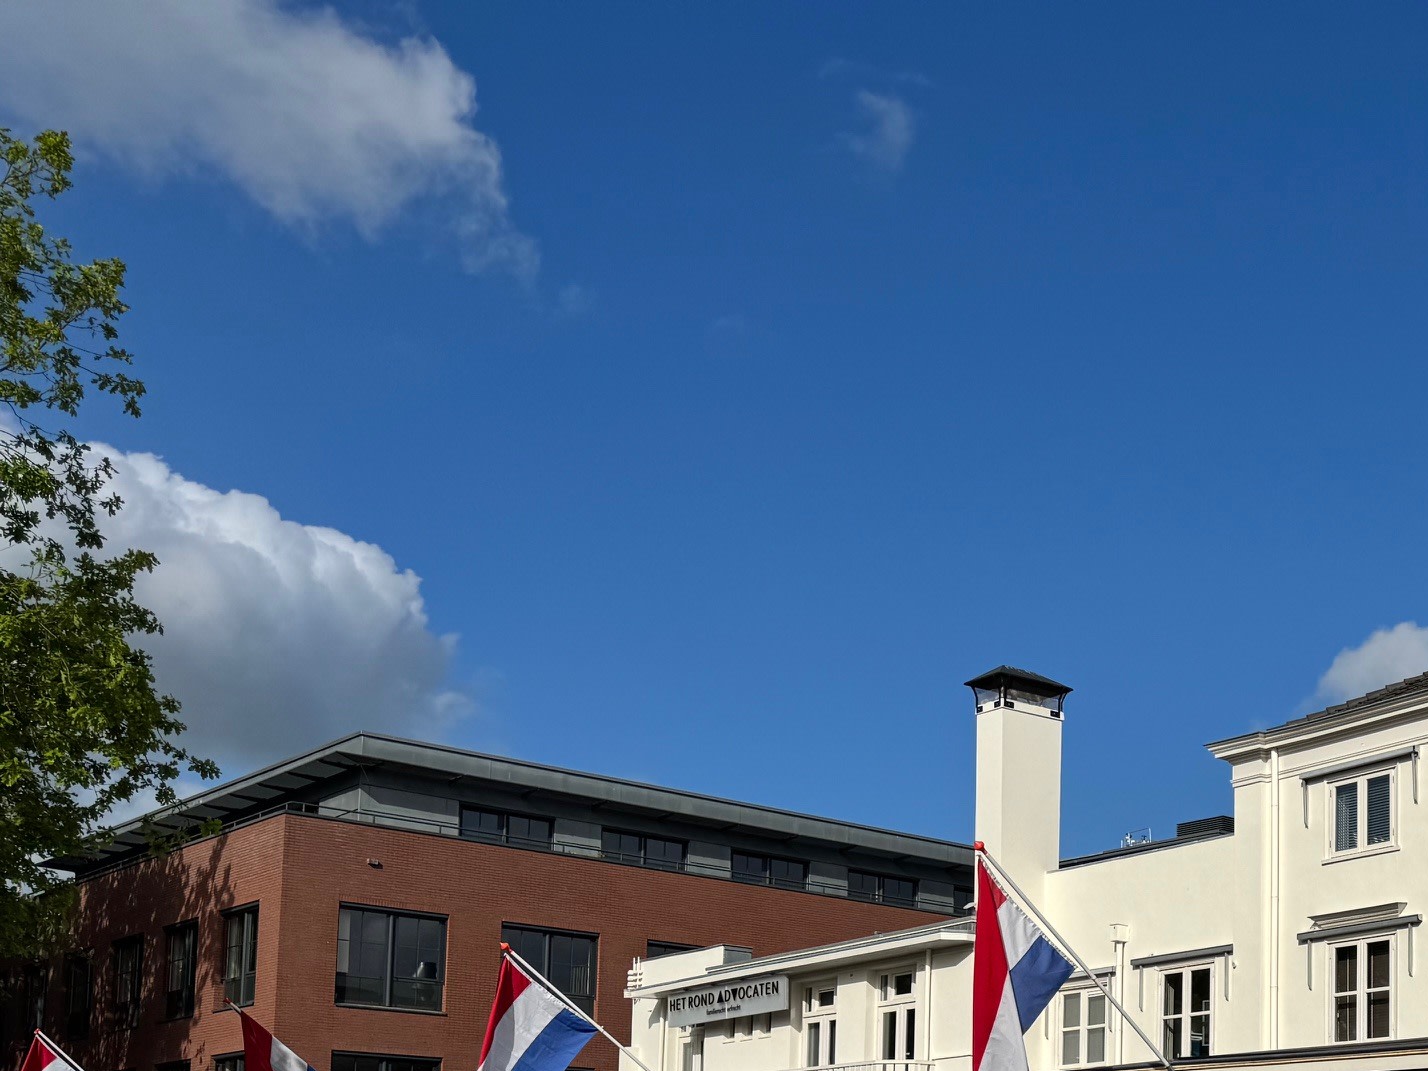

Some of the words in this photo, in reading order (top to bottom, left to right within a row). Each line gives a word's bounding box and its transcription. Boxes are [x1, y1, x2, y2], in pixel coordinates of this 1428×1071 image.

[669, 997, 687, 1012] HET
[688, 992, 715, 1009] ROND
[716, 980, 779, 1004] ADVOCATEN
